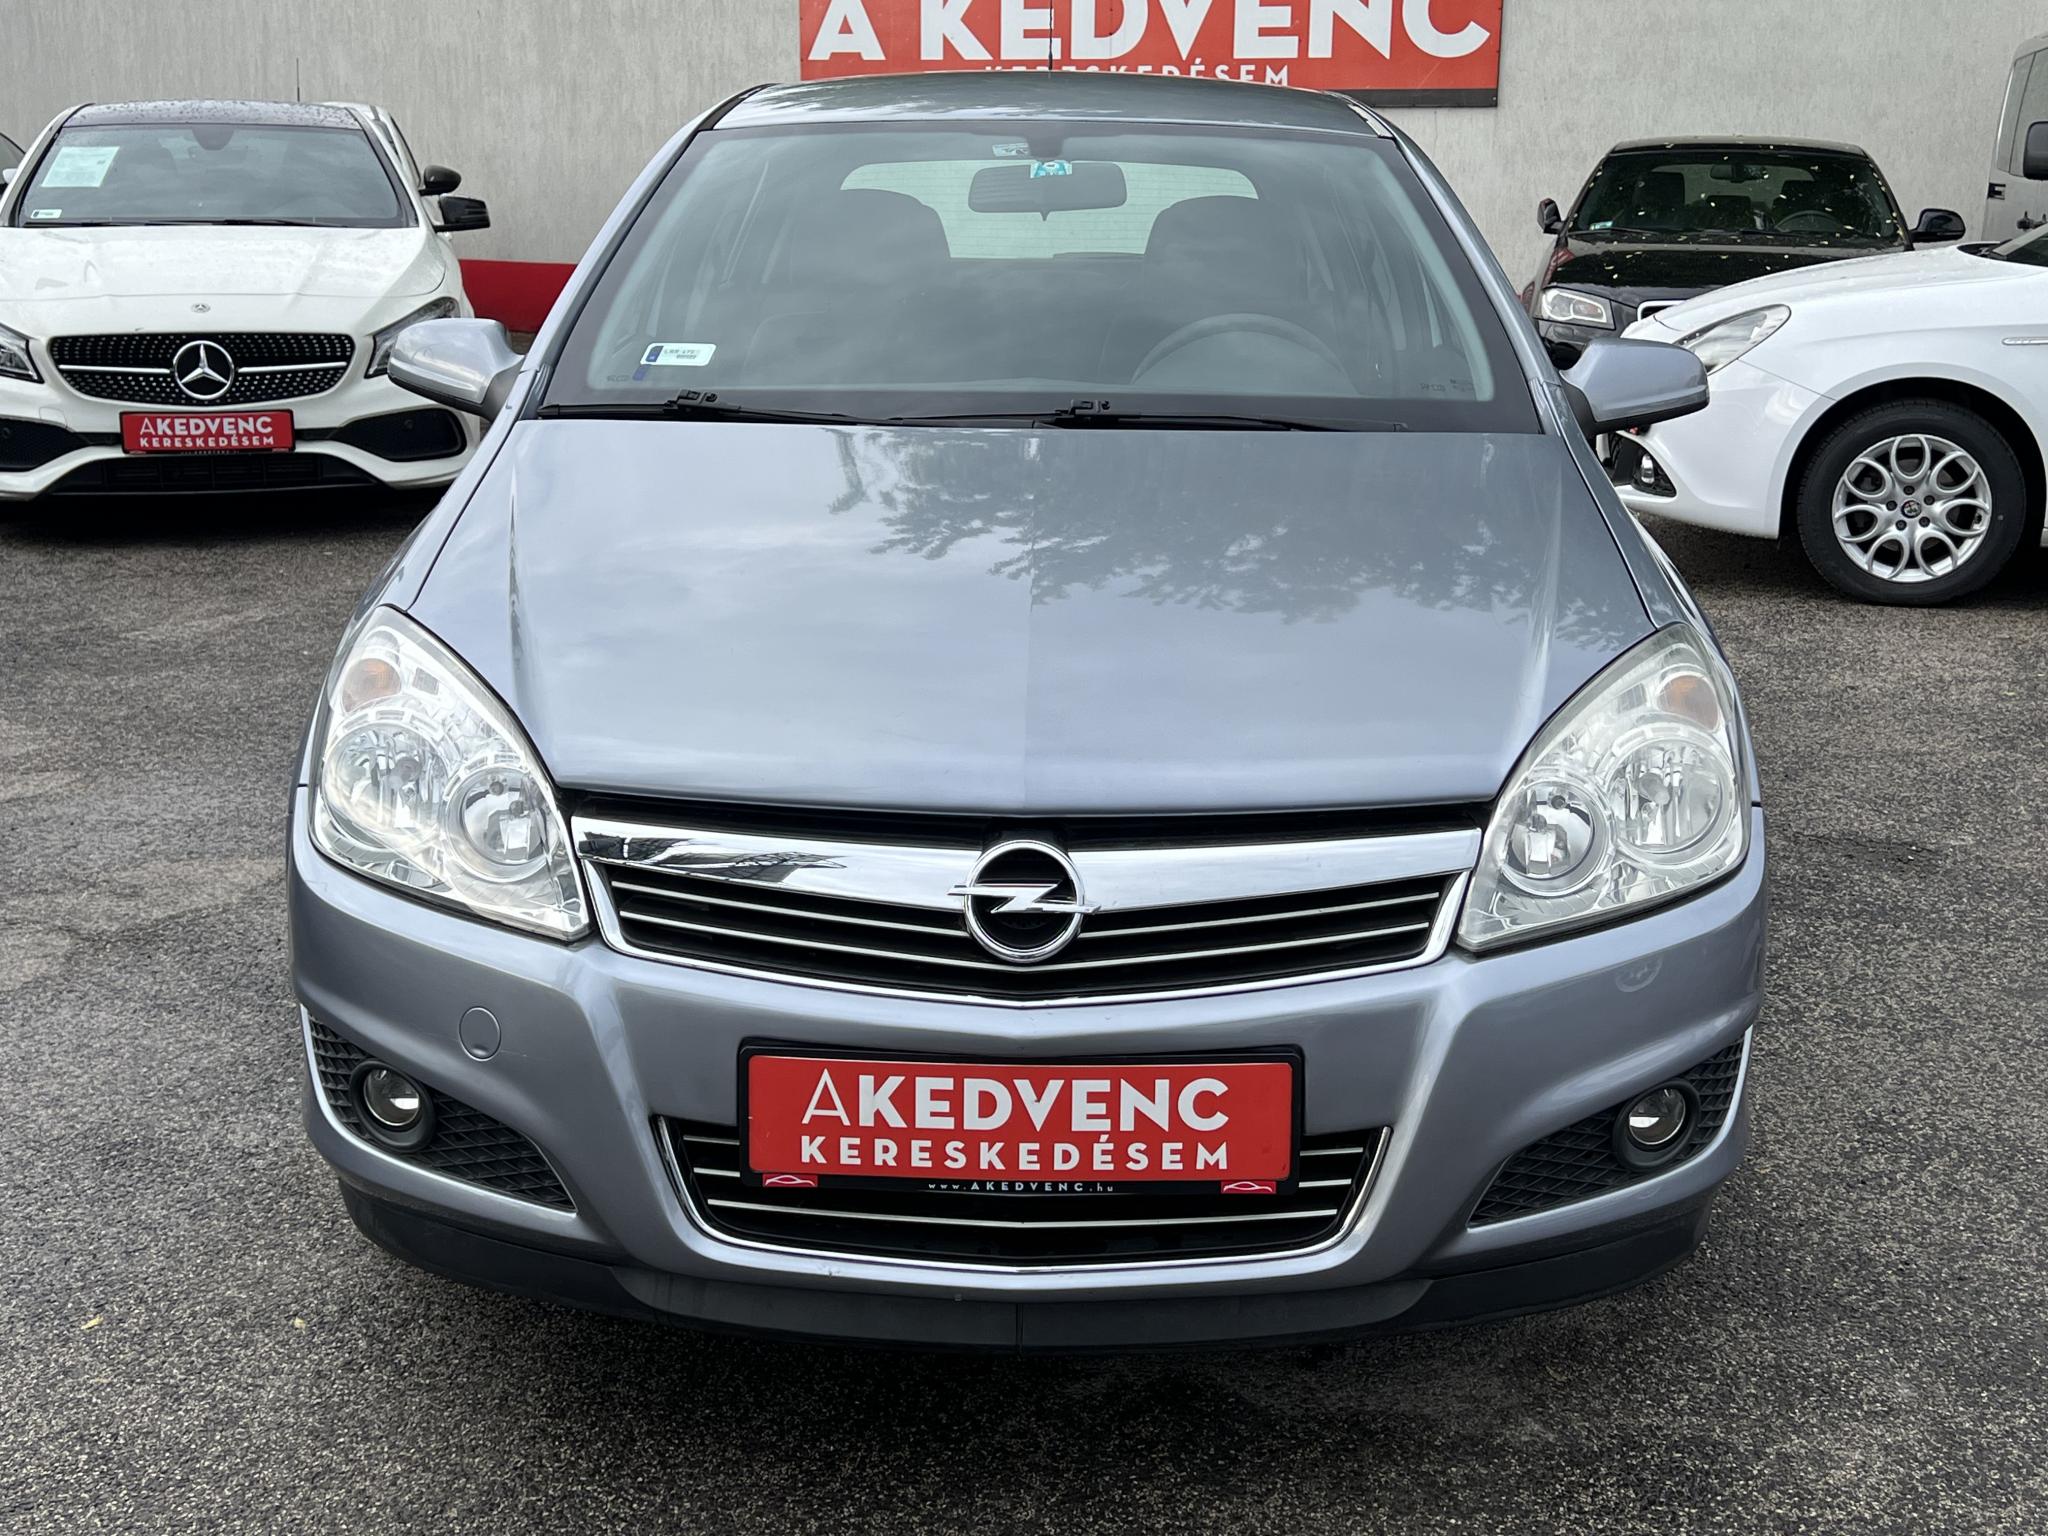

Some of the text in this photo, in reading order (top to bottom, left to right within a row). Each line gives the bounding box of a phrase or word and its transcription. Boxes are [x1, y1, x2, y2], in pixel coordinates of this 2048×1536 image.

[808, 0, 1491, 61] A KEDVENC
[140, 434, 274, 447] KERESKEDÉSEM
[801, 1134, 1228, 1171] KERESKEDÉSEM
